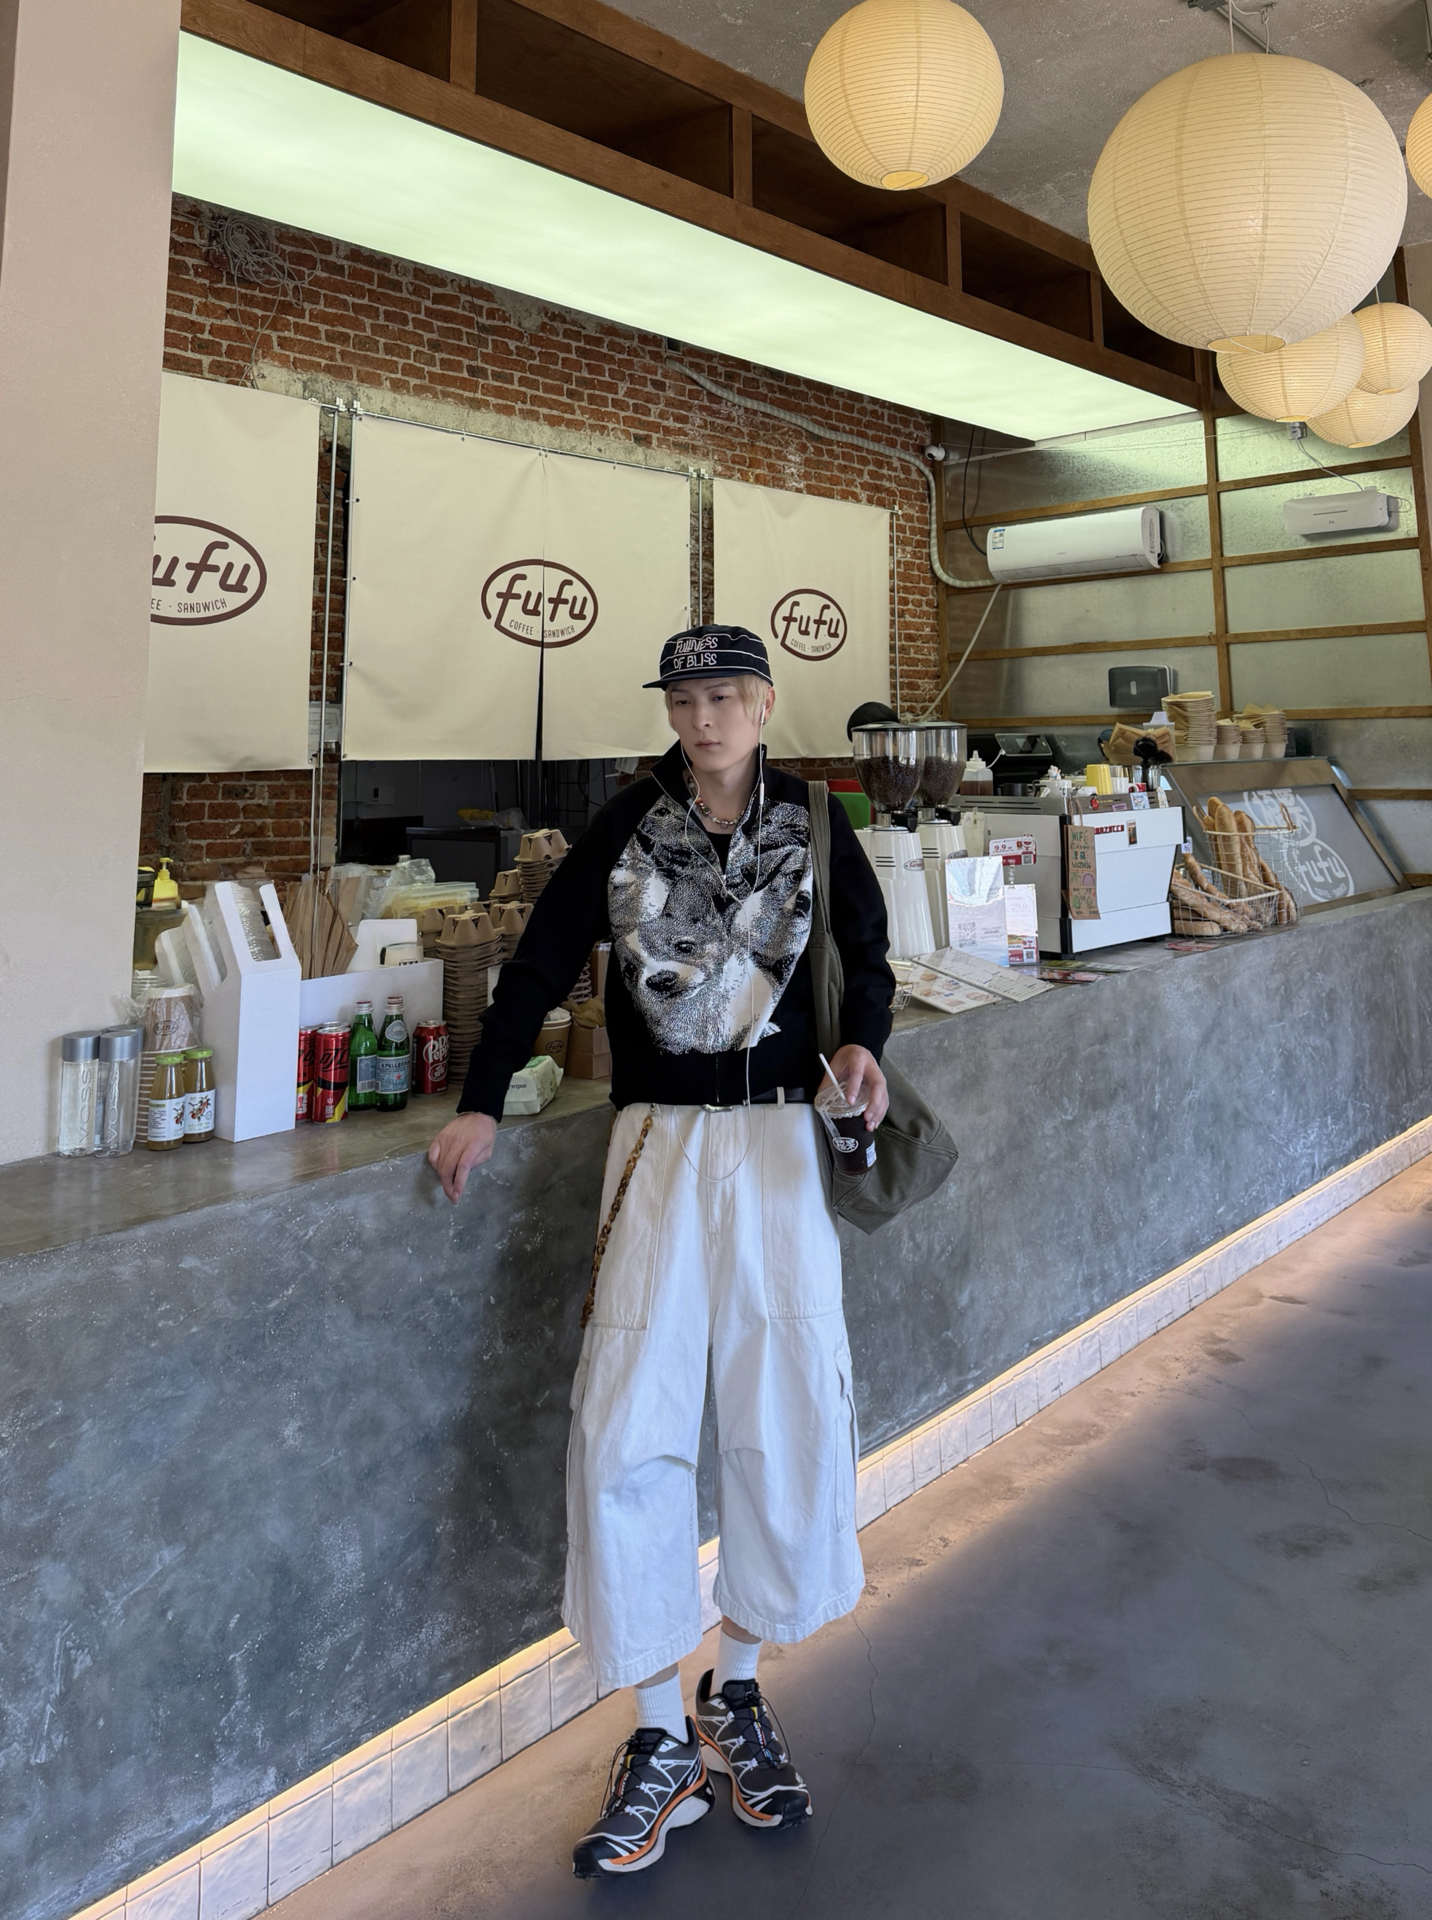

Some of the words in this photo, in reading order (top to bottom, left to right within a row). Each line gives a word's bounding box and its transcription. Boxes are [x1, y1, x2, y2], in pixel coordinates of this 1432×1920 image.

[151, 534, 252, 594] ufu
[177, 598, 228, 614] SANDWICH
[494, 573, 588, 627] fufu
[780, 600, 840, 645] fufu
[509, 619, 534, 636] COFFEE
[543, 624, 576, 639] SANDWICH
[673, 636, 719, 655] FULLNESS
[673, 656, 686, 670] OF
[686, 652, 718, 668] BLISS
[79, 1068, 92, 1143] VOSS
[107, 1068, 120, 1144] VOSS
